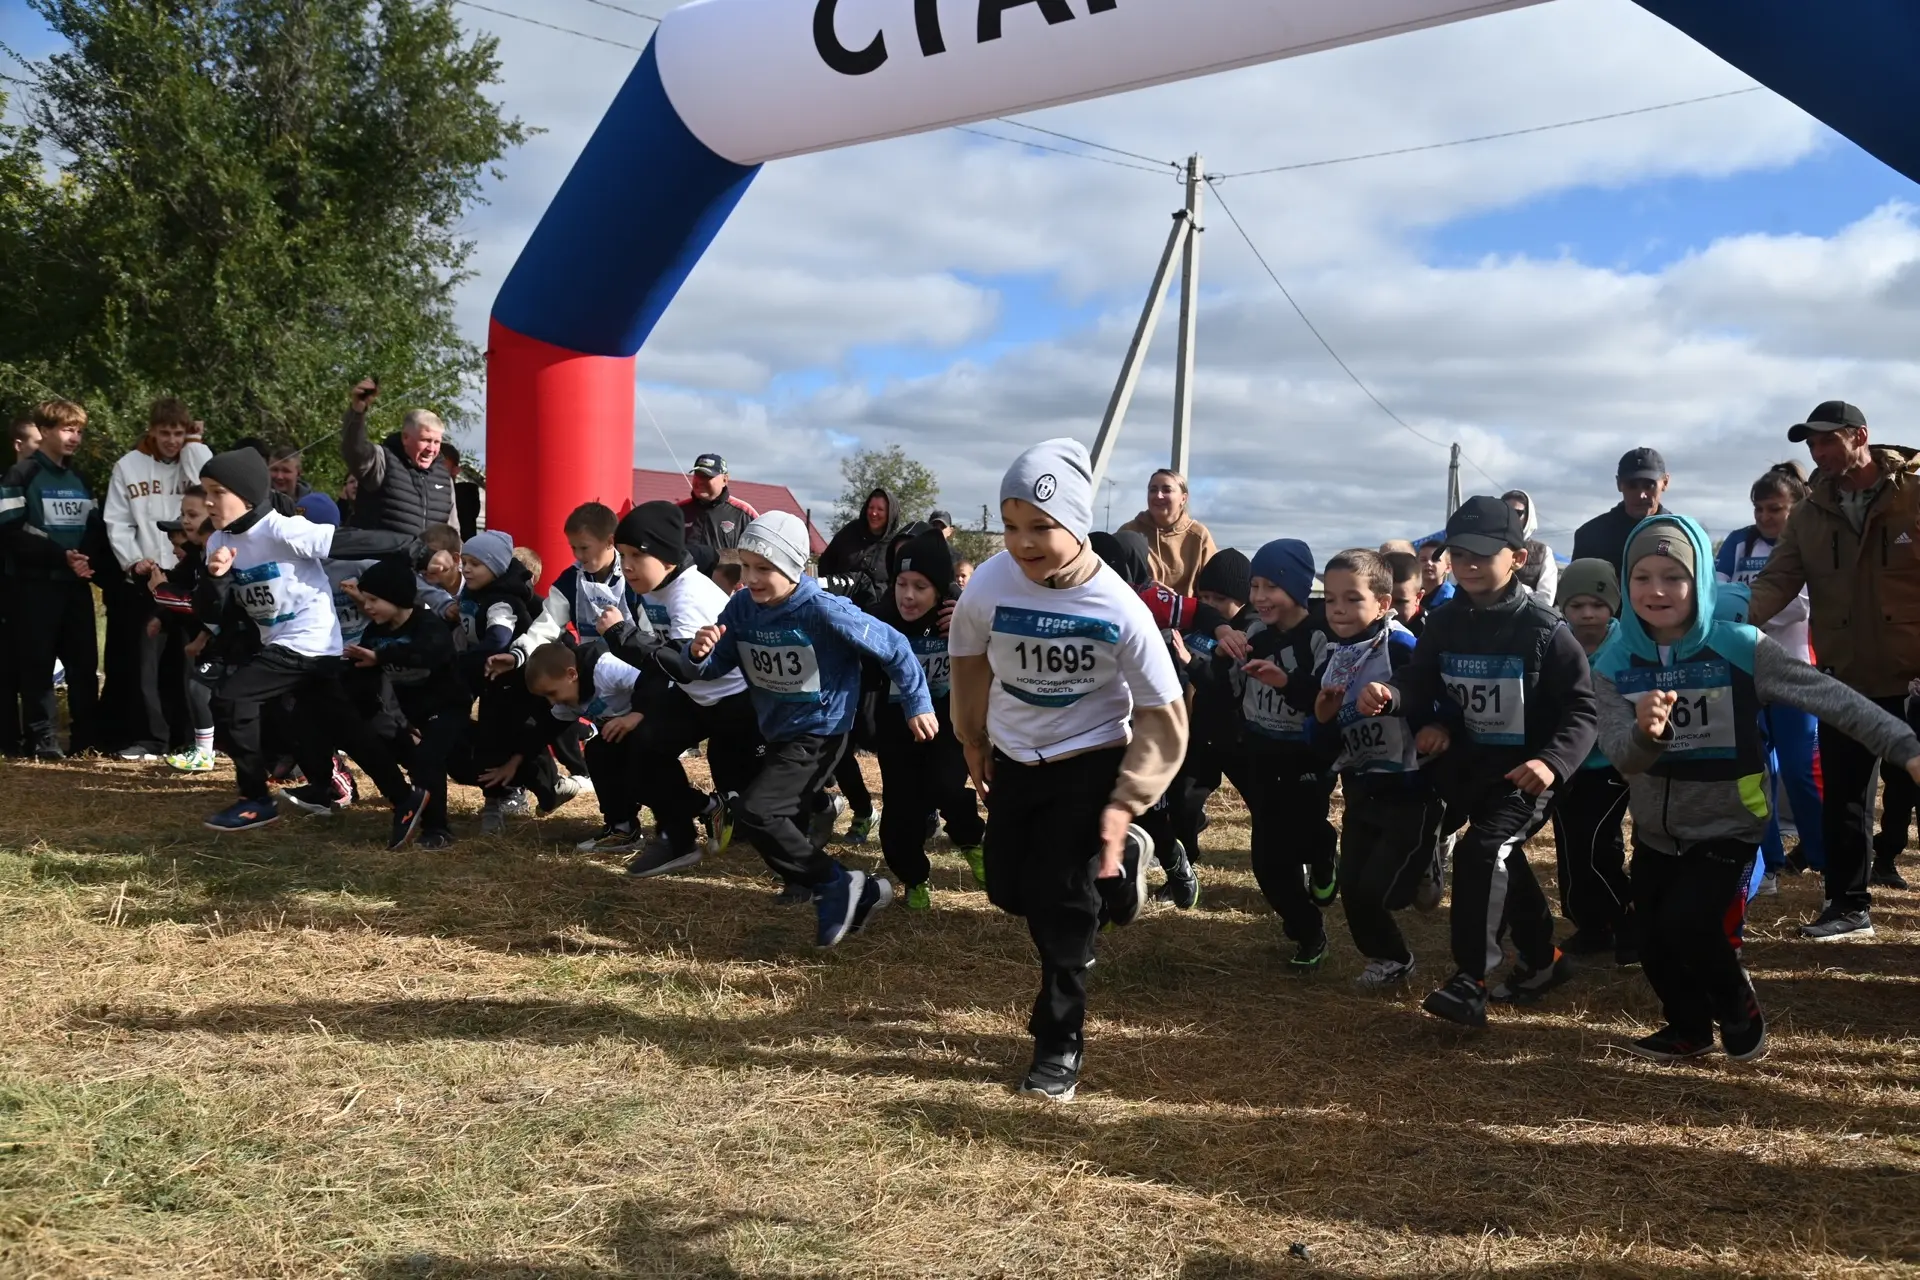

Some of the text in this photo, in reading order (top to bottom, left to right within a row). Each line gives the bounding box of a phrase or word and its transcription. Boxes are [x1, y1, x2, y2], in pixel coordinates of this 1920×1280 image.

[1037, 616, 1076, 630] КРОСС
[750, 648, 802, 676] 8913
[1015, 641, 1096, 674] 11695
[1016, 676, 1095, 686] НОВОСИБИРСКАЯ
